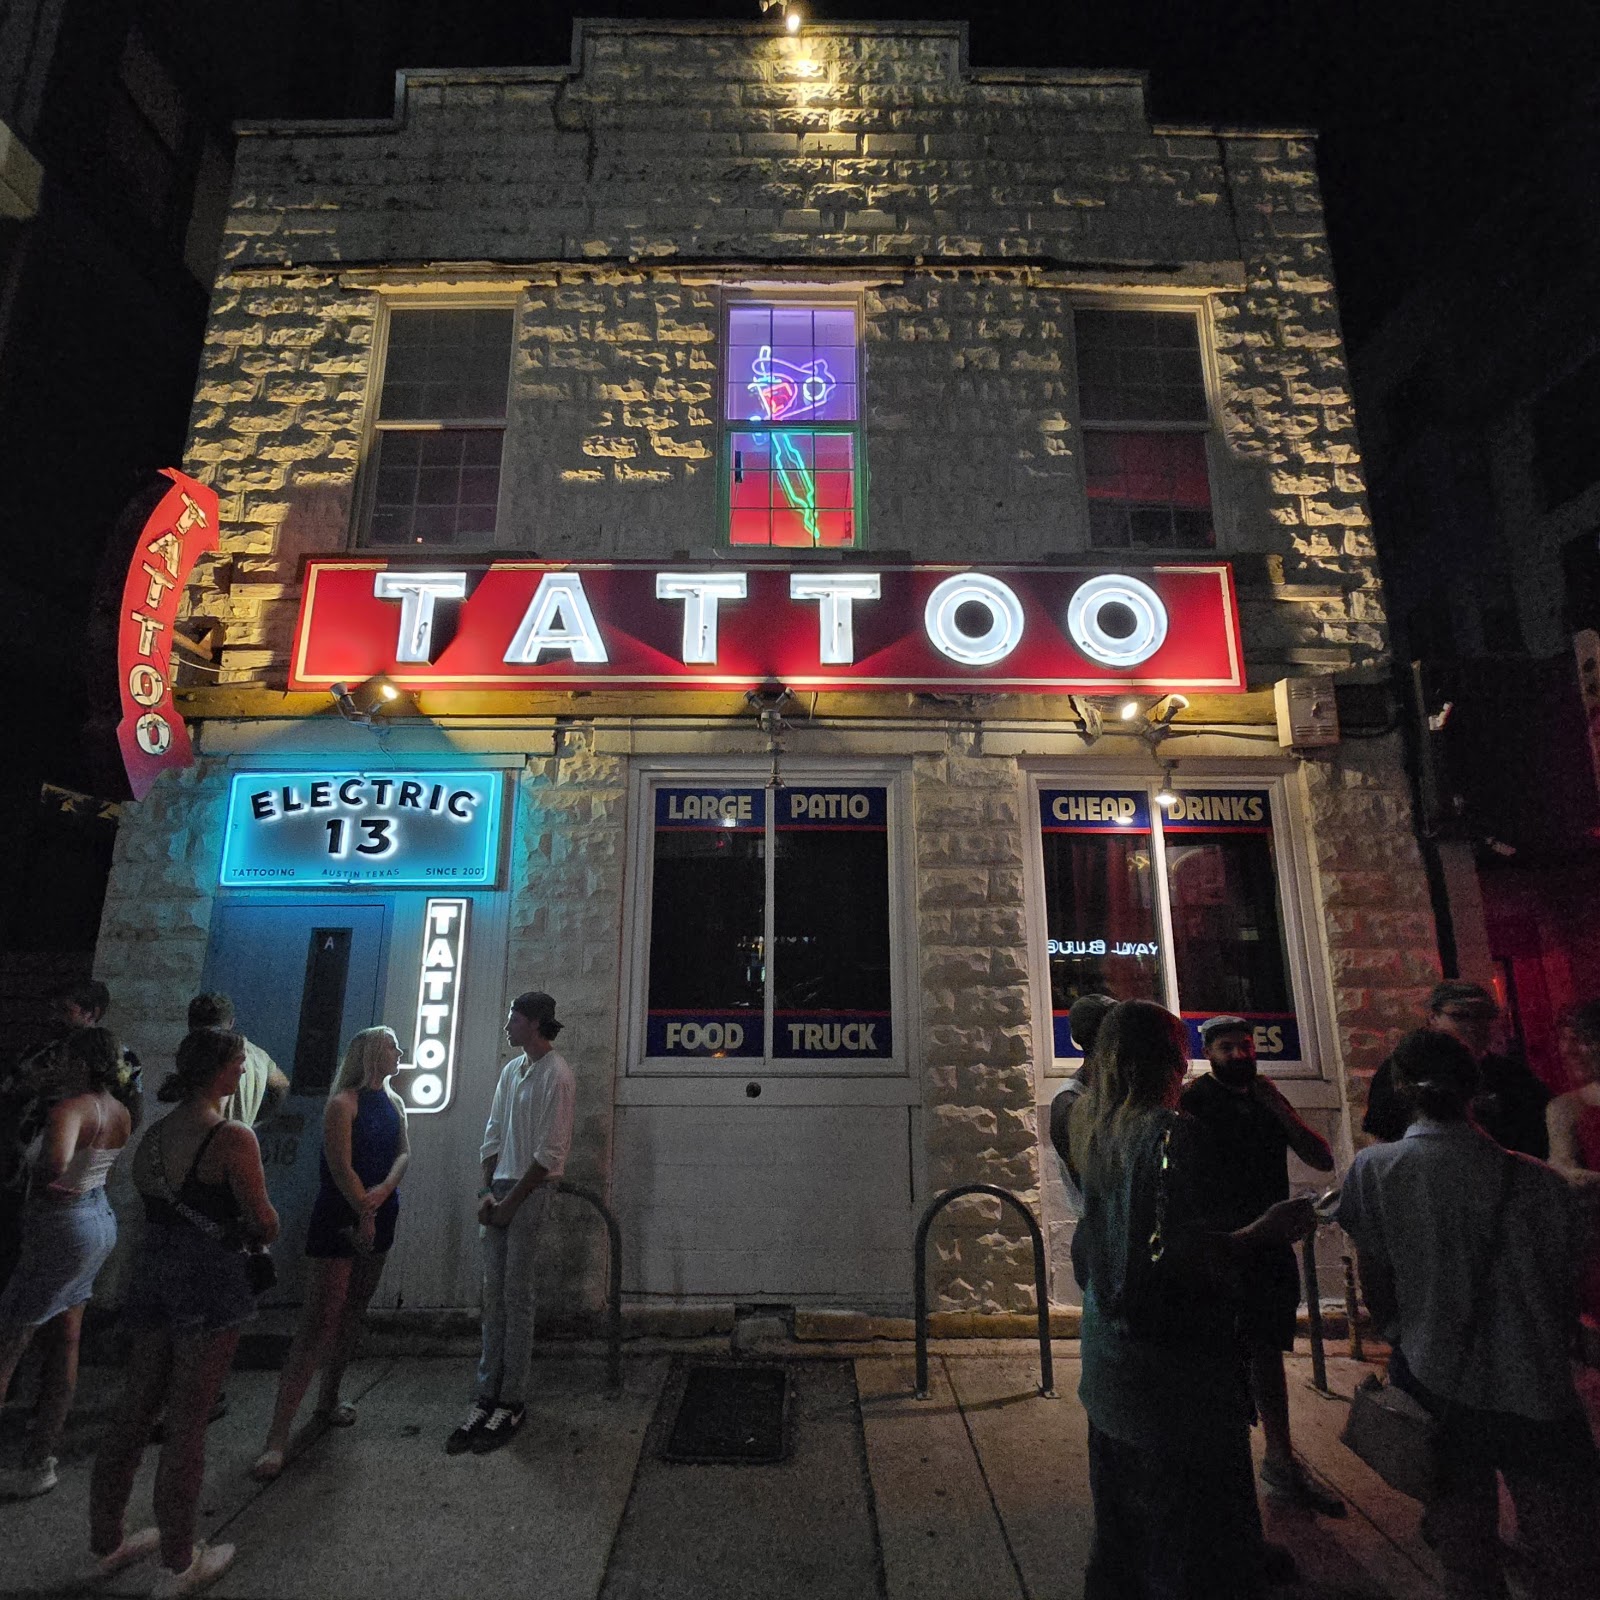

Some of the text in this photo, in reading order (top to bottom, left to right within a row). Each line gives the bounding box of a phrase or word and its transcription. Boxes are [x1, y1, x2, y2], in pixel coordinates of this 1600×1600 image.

[128, 491, 209, 756] TATTOO
[373, 571, 1169, 667] TATTOO
[250, 778, 475, 821] ELECTRIC
[668, 793, 870, 820] LARGE PATIO
[1052, 795, 1264, 822] CHEAP DRINKS
[325, 818, 392, 855] 13
[231, 868, 296, 877] TATTOOING
[425, 867, 458, 876] SINCE
[410, 905, 458, 1106] TATTOO
[666, 1022, 878, 1051] FOOD TRUCK
